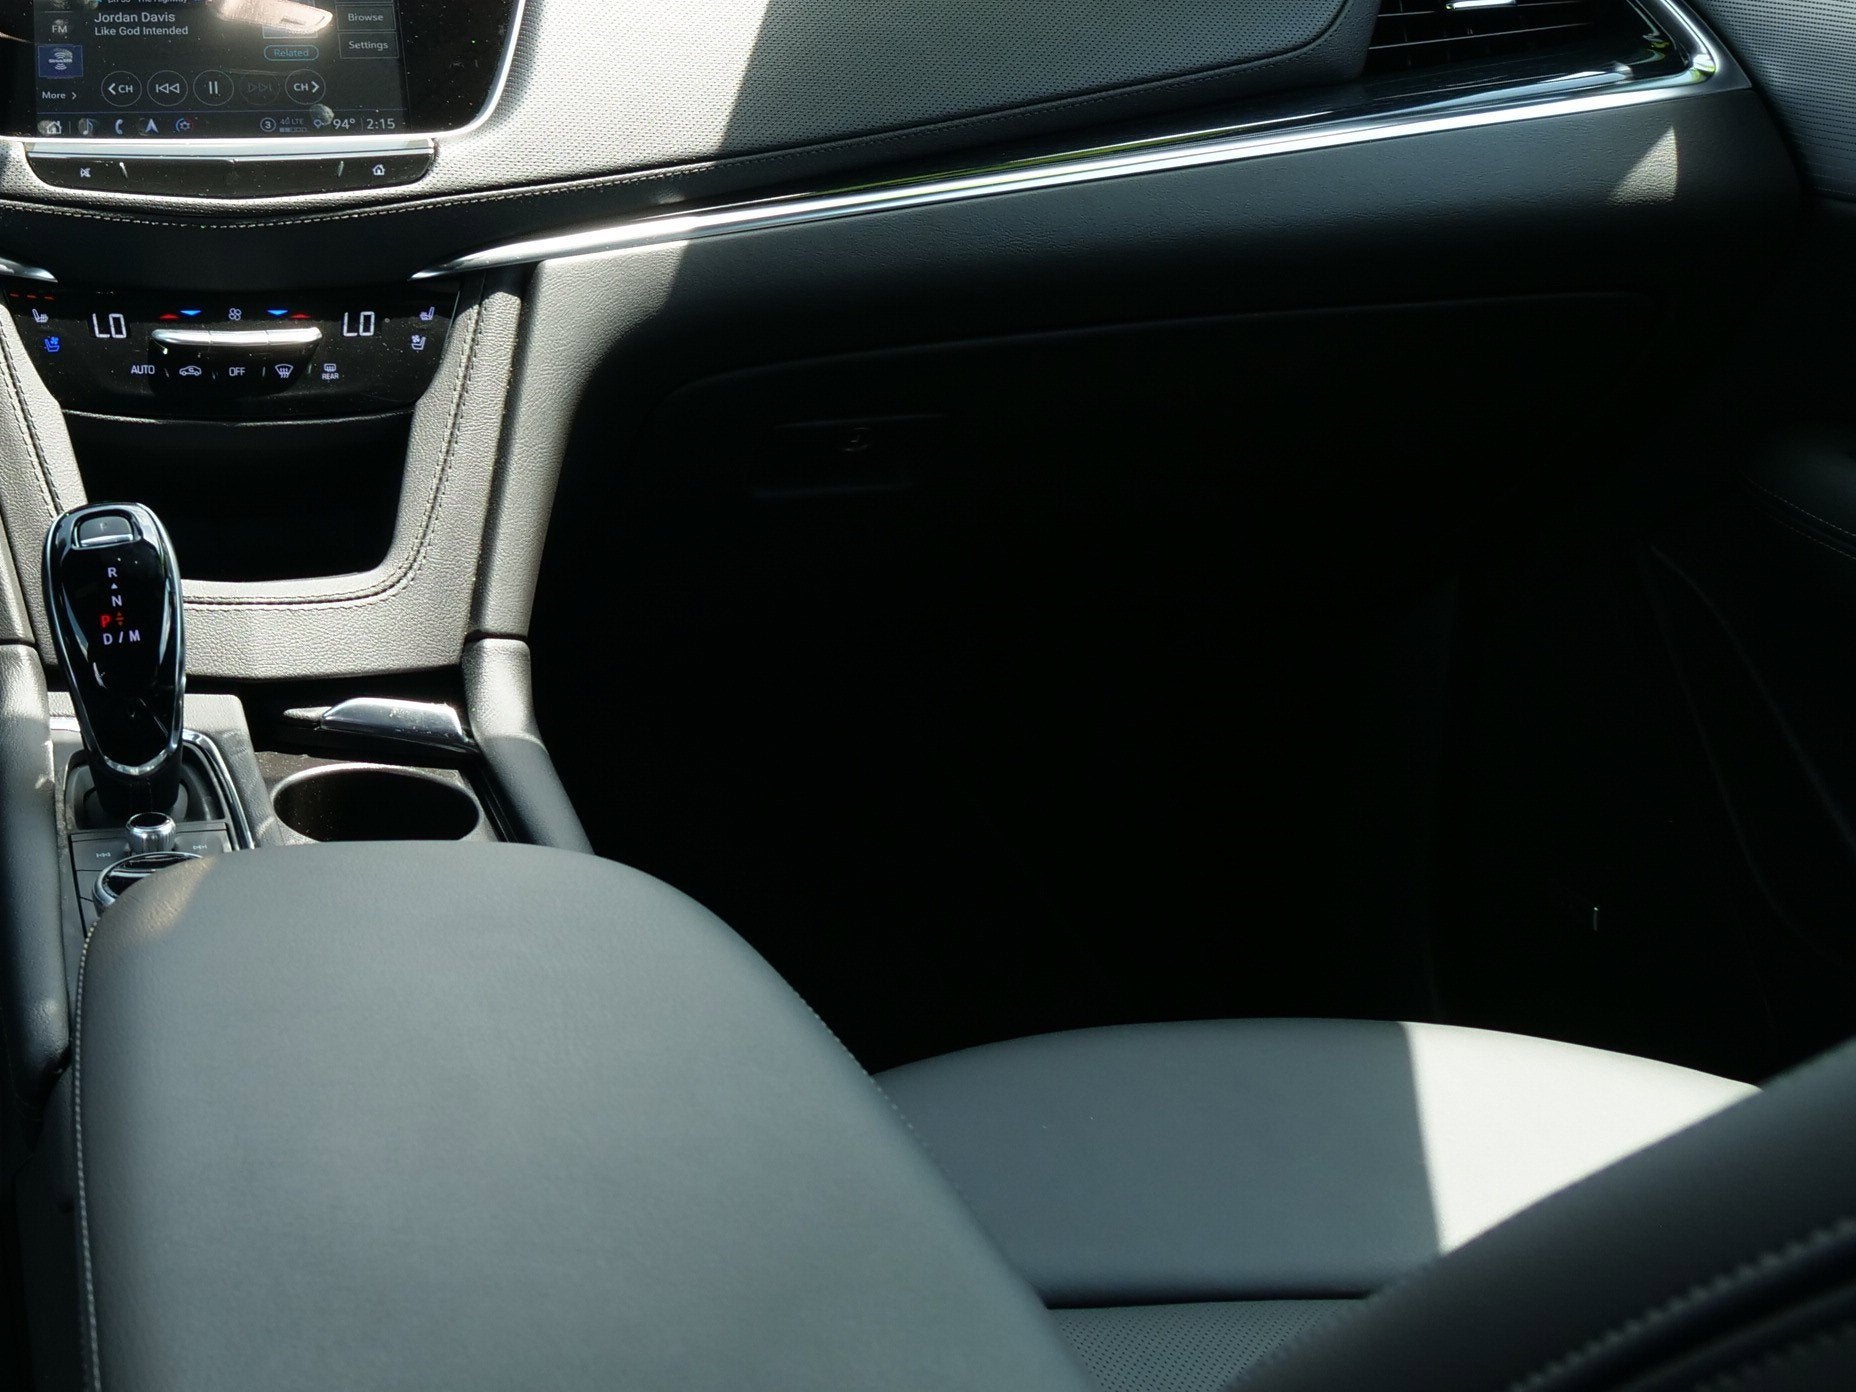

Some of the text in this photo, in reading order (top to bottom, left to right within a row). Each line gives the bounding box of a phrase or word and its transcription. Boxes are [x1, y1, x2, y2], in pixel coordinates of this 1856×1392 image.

[94, 12, 176, 23] Jordan Davis
[348, 13, 384, 21] Browse
[52, 25, 68, 33] FM
[95, 26, 189, 36] Like God Intended
[349, 40, 389, 51] Settings
[274, 48, 309, 57] Related
[118, 85, 133, 93] CH
[293, 82, 309, 92] CH
[333, 118, 355, 130] 94°
[366, 118, 396, 130] 2:15
[92, 313, 127, 339] LO
[343, 311, 375, 337] LO
[130, 365, 156, 375] AUTO
[229, 366, 246, 376] OFF
[107, 567, 118, 578] R
[111, 594, 123, 607] N
[100, 614, 111, 628] P
